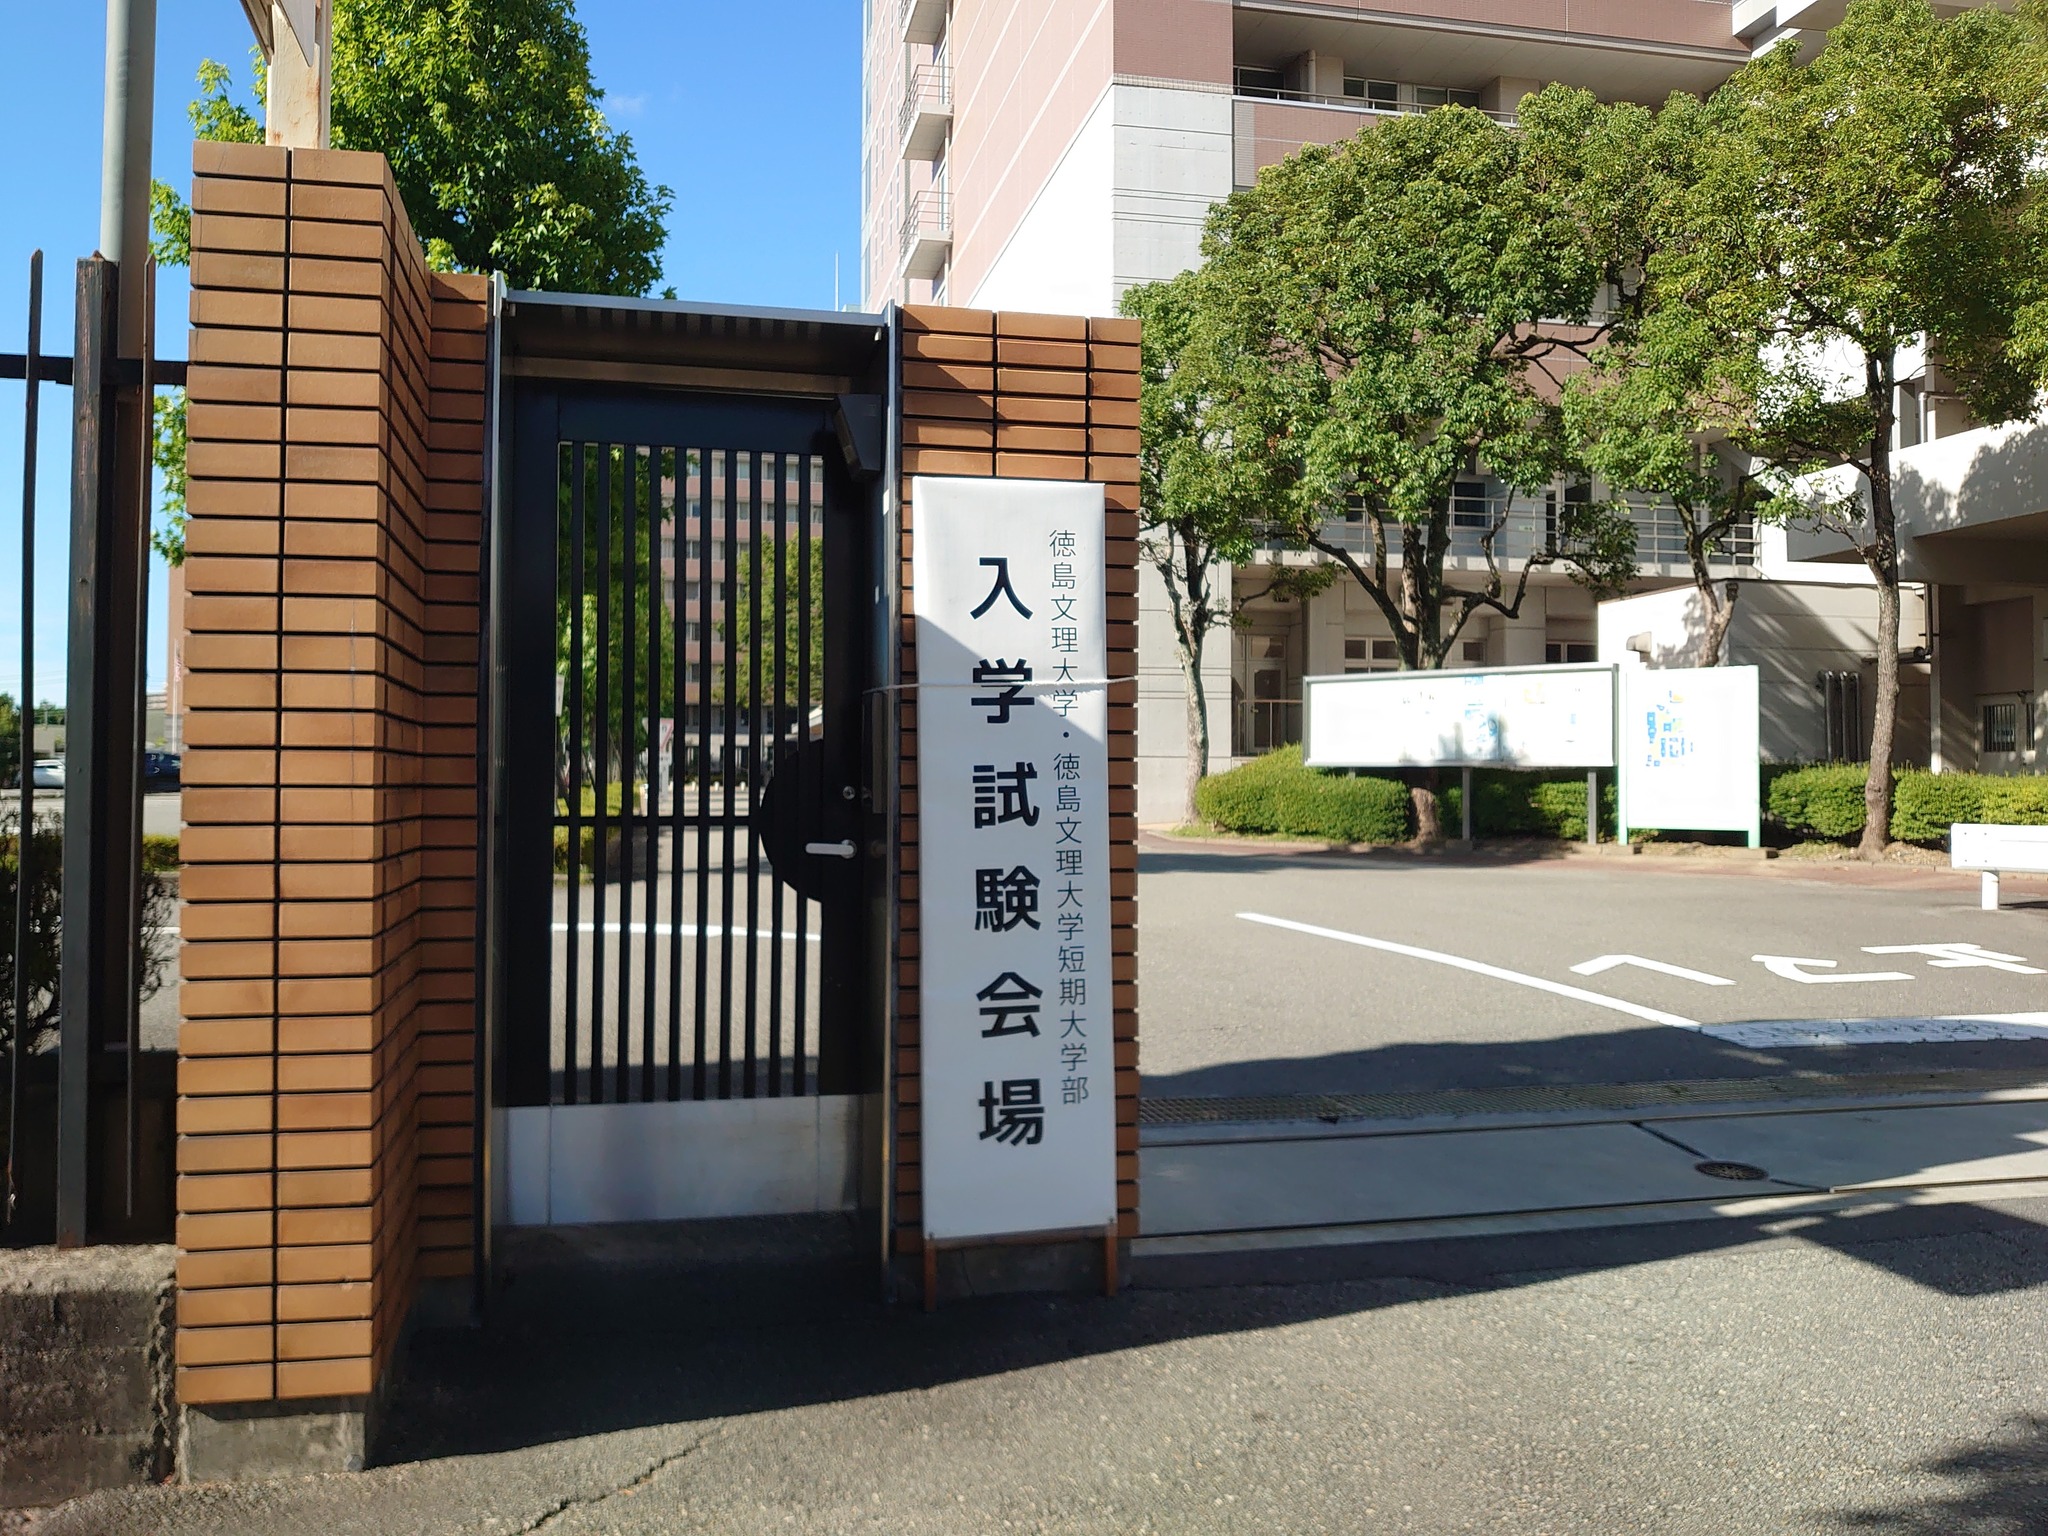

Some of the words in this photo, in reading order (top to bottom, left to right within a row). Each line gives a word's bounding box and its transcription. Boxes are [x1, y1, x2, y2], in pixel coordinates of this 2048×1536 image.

[969, 556, 1045, 1146] 入学試験会場
[1048, 529, 1090, 1105] 徳島文理大学・徳島文理大学短期大学部
